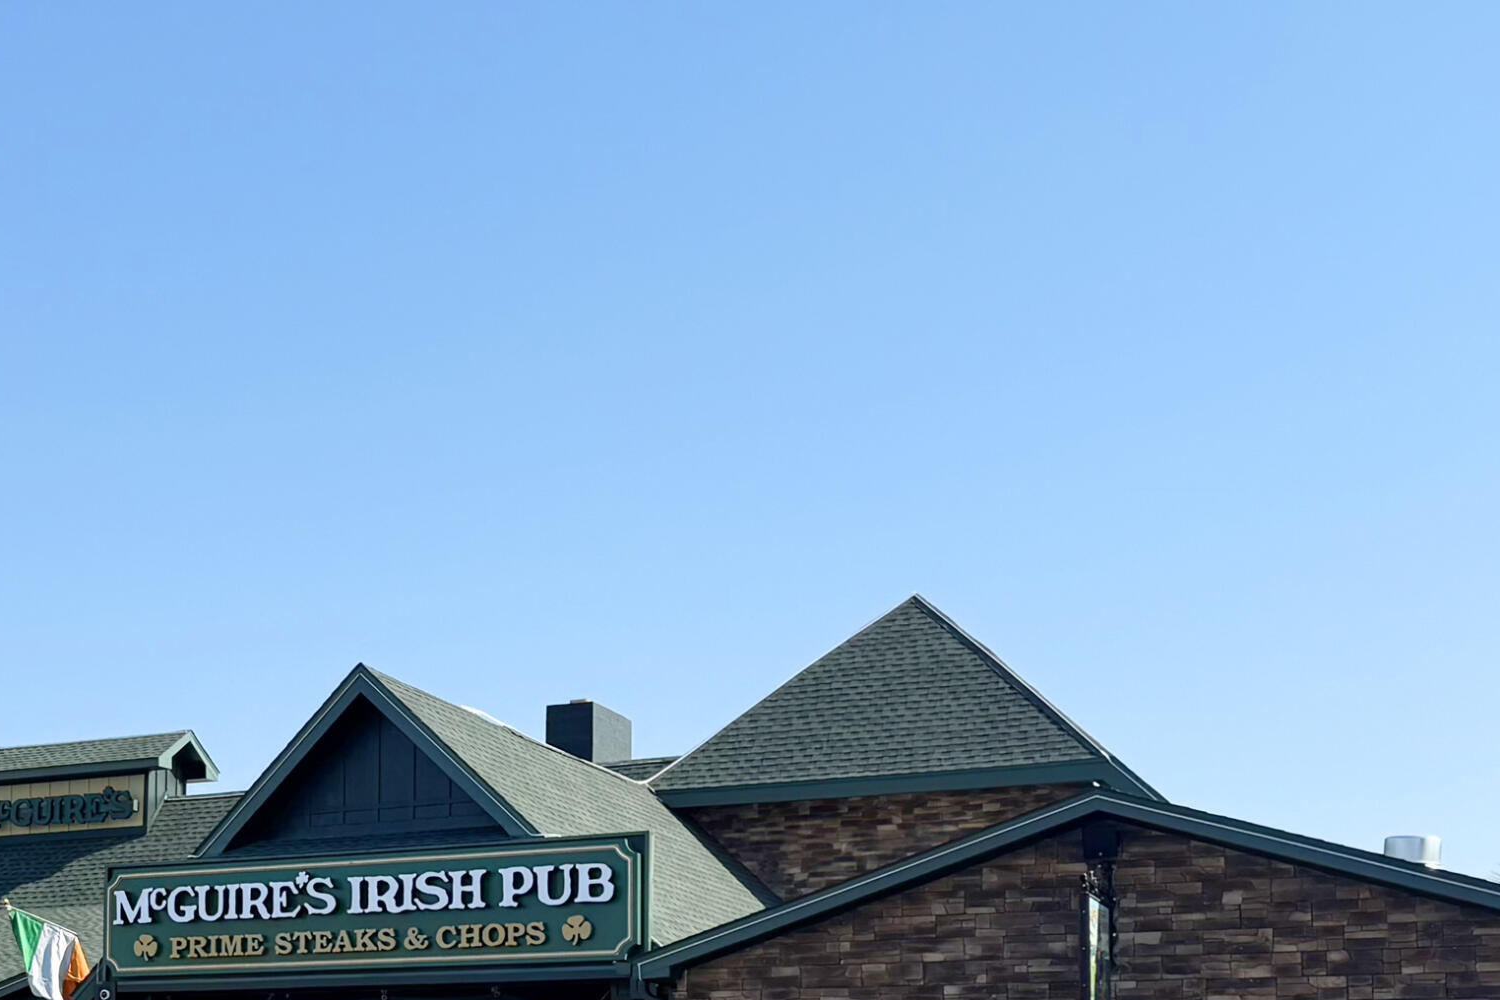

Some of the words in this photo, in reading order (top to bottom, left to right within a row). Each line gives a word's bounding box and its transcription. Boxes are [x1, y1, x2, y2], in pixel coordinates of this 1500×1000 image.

[347, 868, 487, 914] IRISH
[498, 862, 615, 907] PUB
[169, 933, 264, 959] PRIME
[274, 927, 396, 955] STEAKS
[403, 927, 429, 950] &
[435, 921, 547, 948] CHOPS
